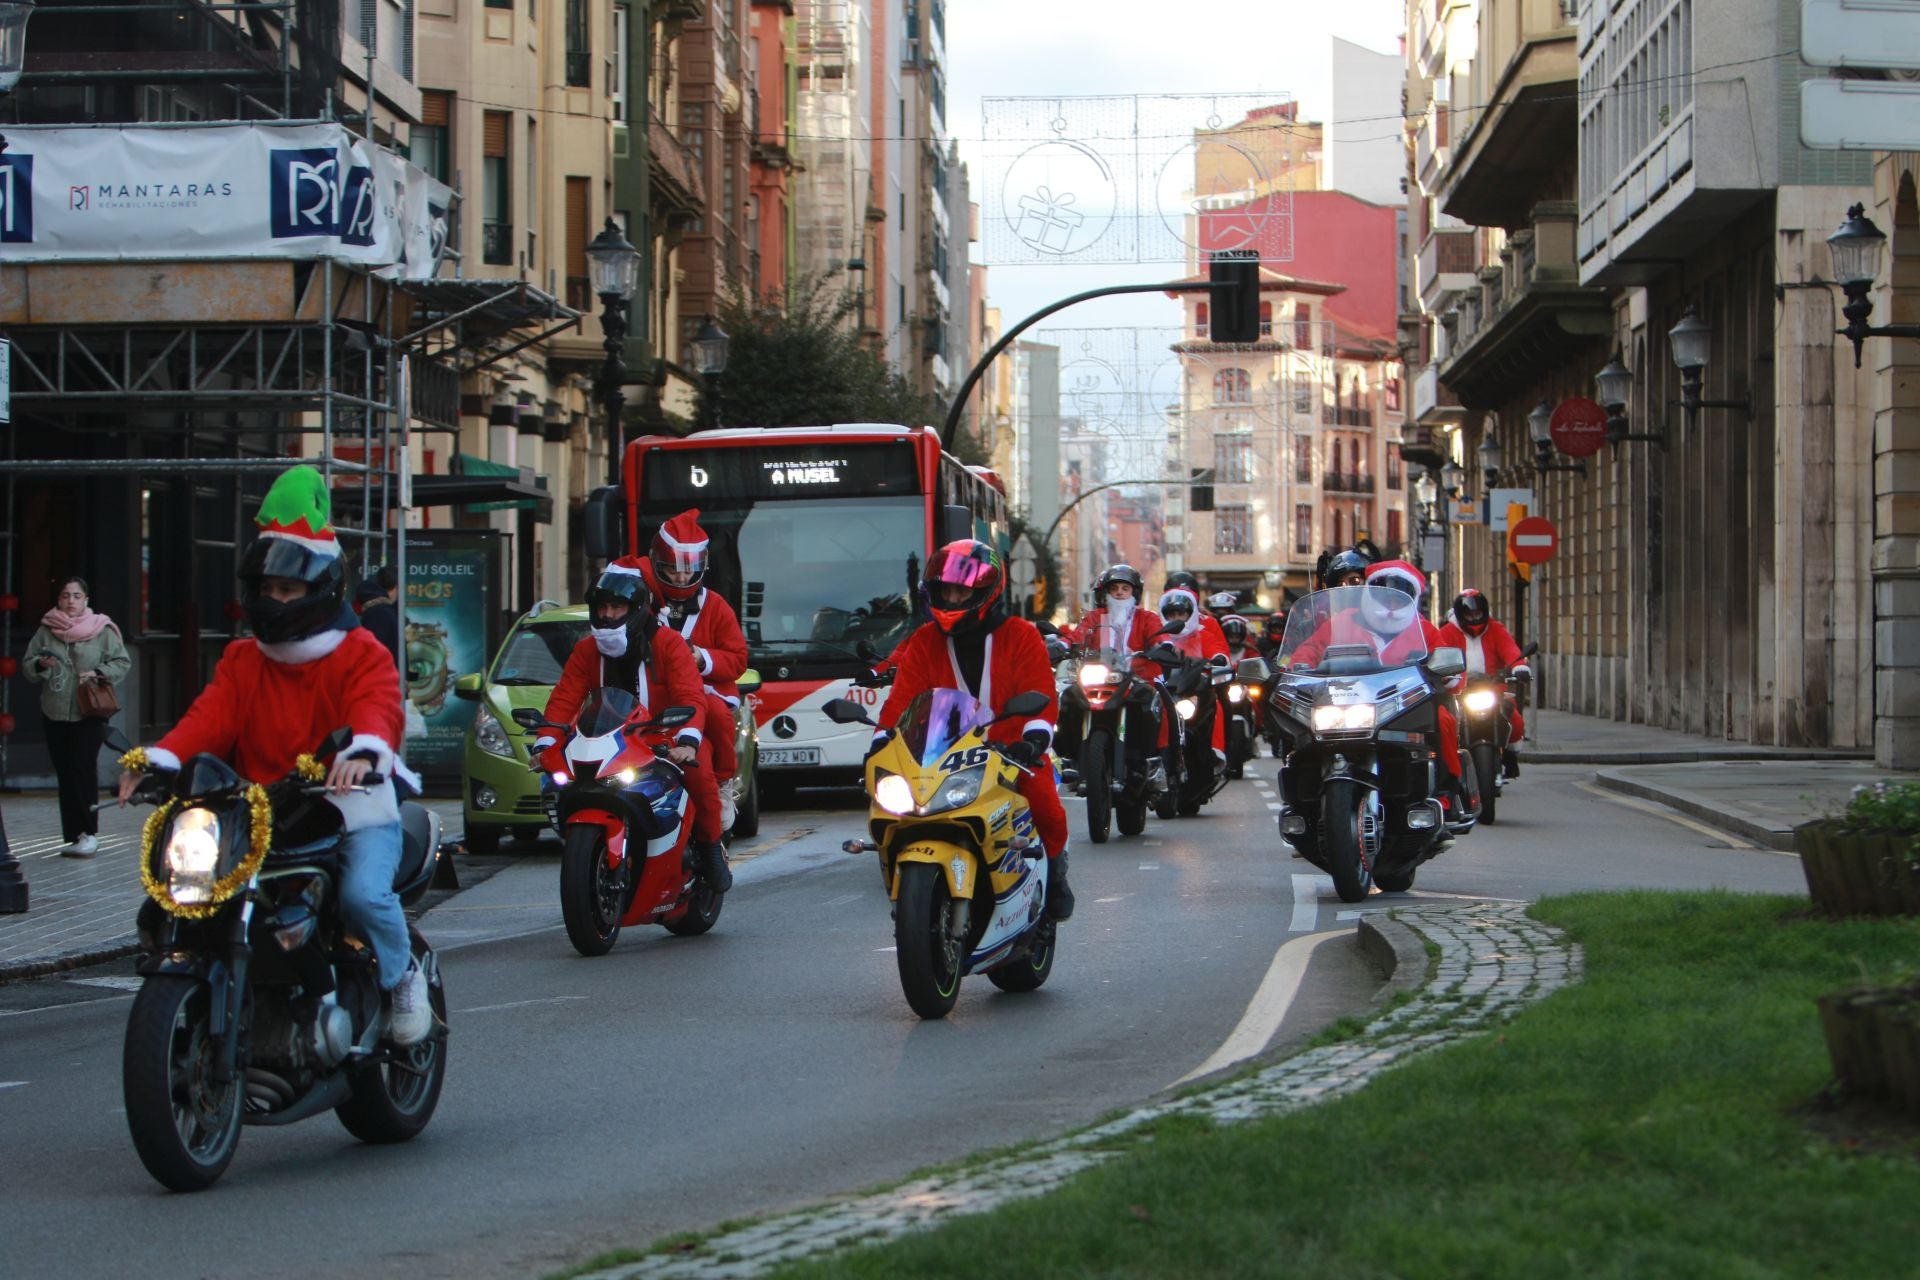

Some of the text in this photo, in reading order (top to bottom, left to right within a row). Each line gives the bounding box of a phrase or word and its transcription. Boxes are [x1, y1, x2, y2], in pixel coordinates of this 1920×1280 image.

[98, 183, 232, 198] MANTARAS
[771, 468, 840, 484] A MUSEL
[409, 564, 475, 576] DU SOLEIL
[844, 689, 877, 706] 410
[759, 751, 788, 763] 9732
[937, 745, 991, 773] 46
